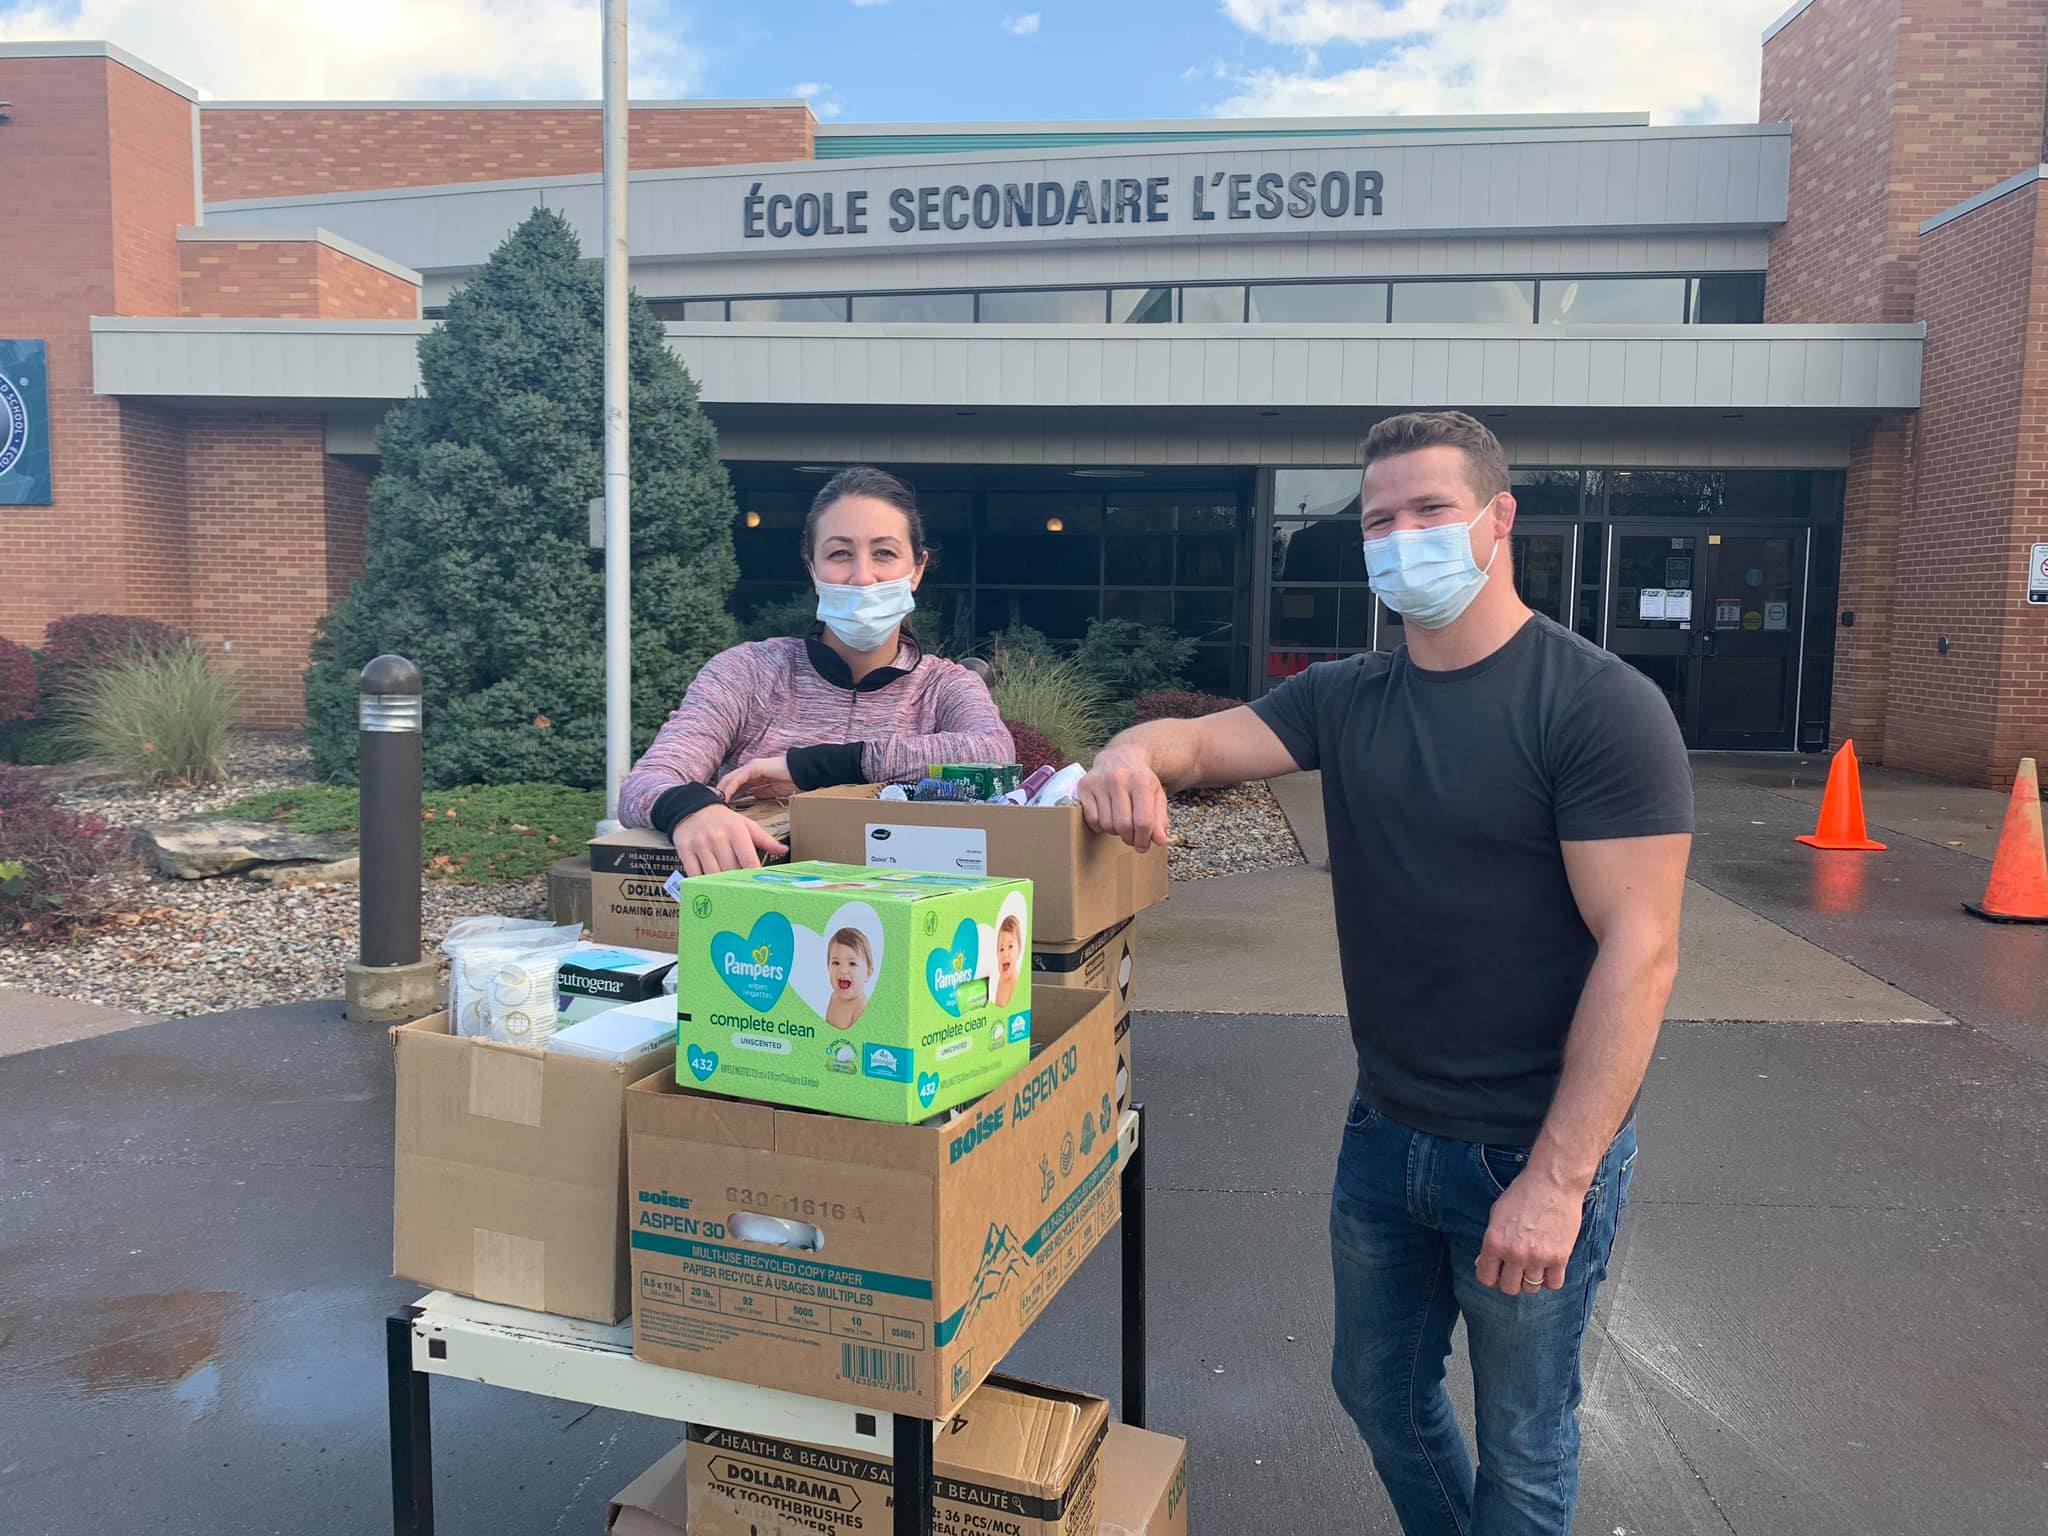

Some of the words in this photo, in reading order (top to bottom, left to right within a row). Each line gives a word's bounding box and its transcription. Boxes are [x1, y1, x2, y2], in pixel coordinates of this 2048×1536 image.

[743, 183, 868, 238] ÉCOLE
[889, 177, 1169, 232] SECONDAIRE
[1193, 170, 1384, 220] L'ESSOR
[7, 393, 23, 433] SCHOOL
[611, 904, 653, 916] FOAMING
[641, 928, 677, 940] FRAGILE
[725, 951, 784, 981] Pampers
[556, 972, 621, 993] eutrogena
[935, 967, 974, 992] Pampers
[710, 1013, 775, 1033] complete
[778, 1020, 815, 1039] clean
[921, 1022, 963, 1047] complete
[964, 1016, 987, 1033] clean
[740, 1037, 782, 1050] UNSCENTED
[692, 1057, 713, 1072] 432
[920, 1082, 936, 1097] 432
[1012, 1061, 1059, 1128] ASPEN
[1061, 1044, 1077, 1082] 30
[640, 1210, 698, 1235] ASPEN
[702, 1221, 725, 1240] 30
[692, 1245, 741, 1265] MULTI-USE
[743, 1254, 796, 1274] RECYCLED
[798, 1264, 826, 1279] COPY
[828, 1270, 863, 1286] PAPER
[682, 1262, 717, 1278] PAPIER
[718, 1268, 764, 1288] RECYCLÉ
[774, 1279, 816, 1297] USAGES
[817, 1286, 874, 1307] MULTIPLES
[691, 1287, 702, 1296] 20
[793, 1306, 813, 1317] 5000
[851, 1317, 862, 1327] 10
[720, 1434, 777, 1458] HEALTH
[782, 1446, 794, 1462] &
[727, 1463, 842, 1504] DOLLARAMA
[948, 1483, 1009, 1510] BEAUTÉ
[738, 1489, 864, 1530] TOOTHBRUSHES
[944, 1509, 960, 1523] 36
